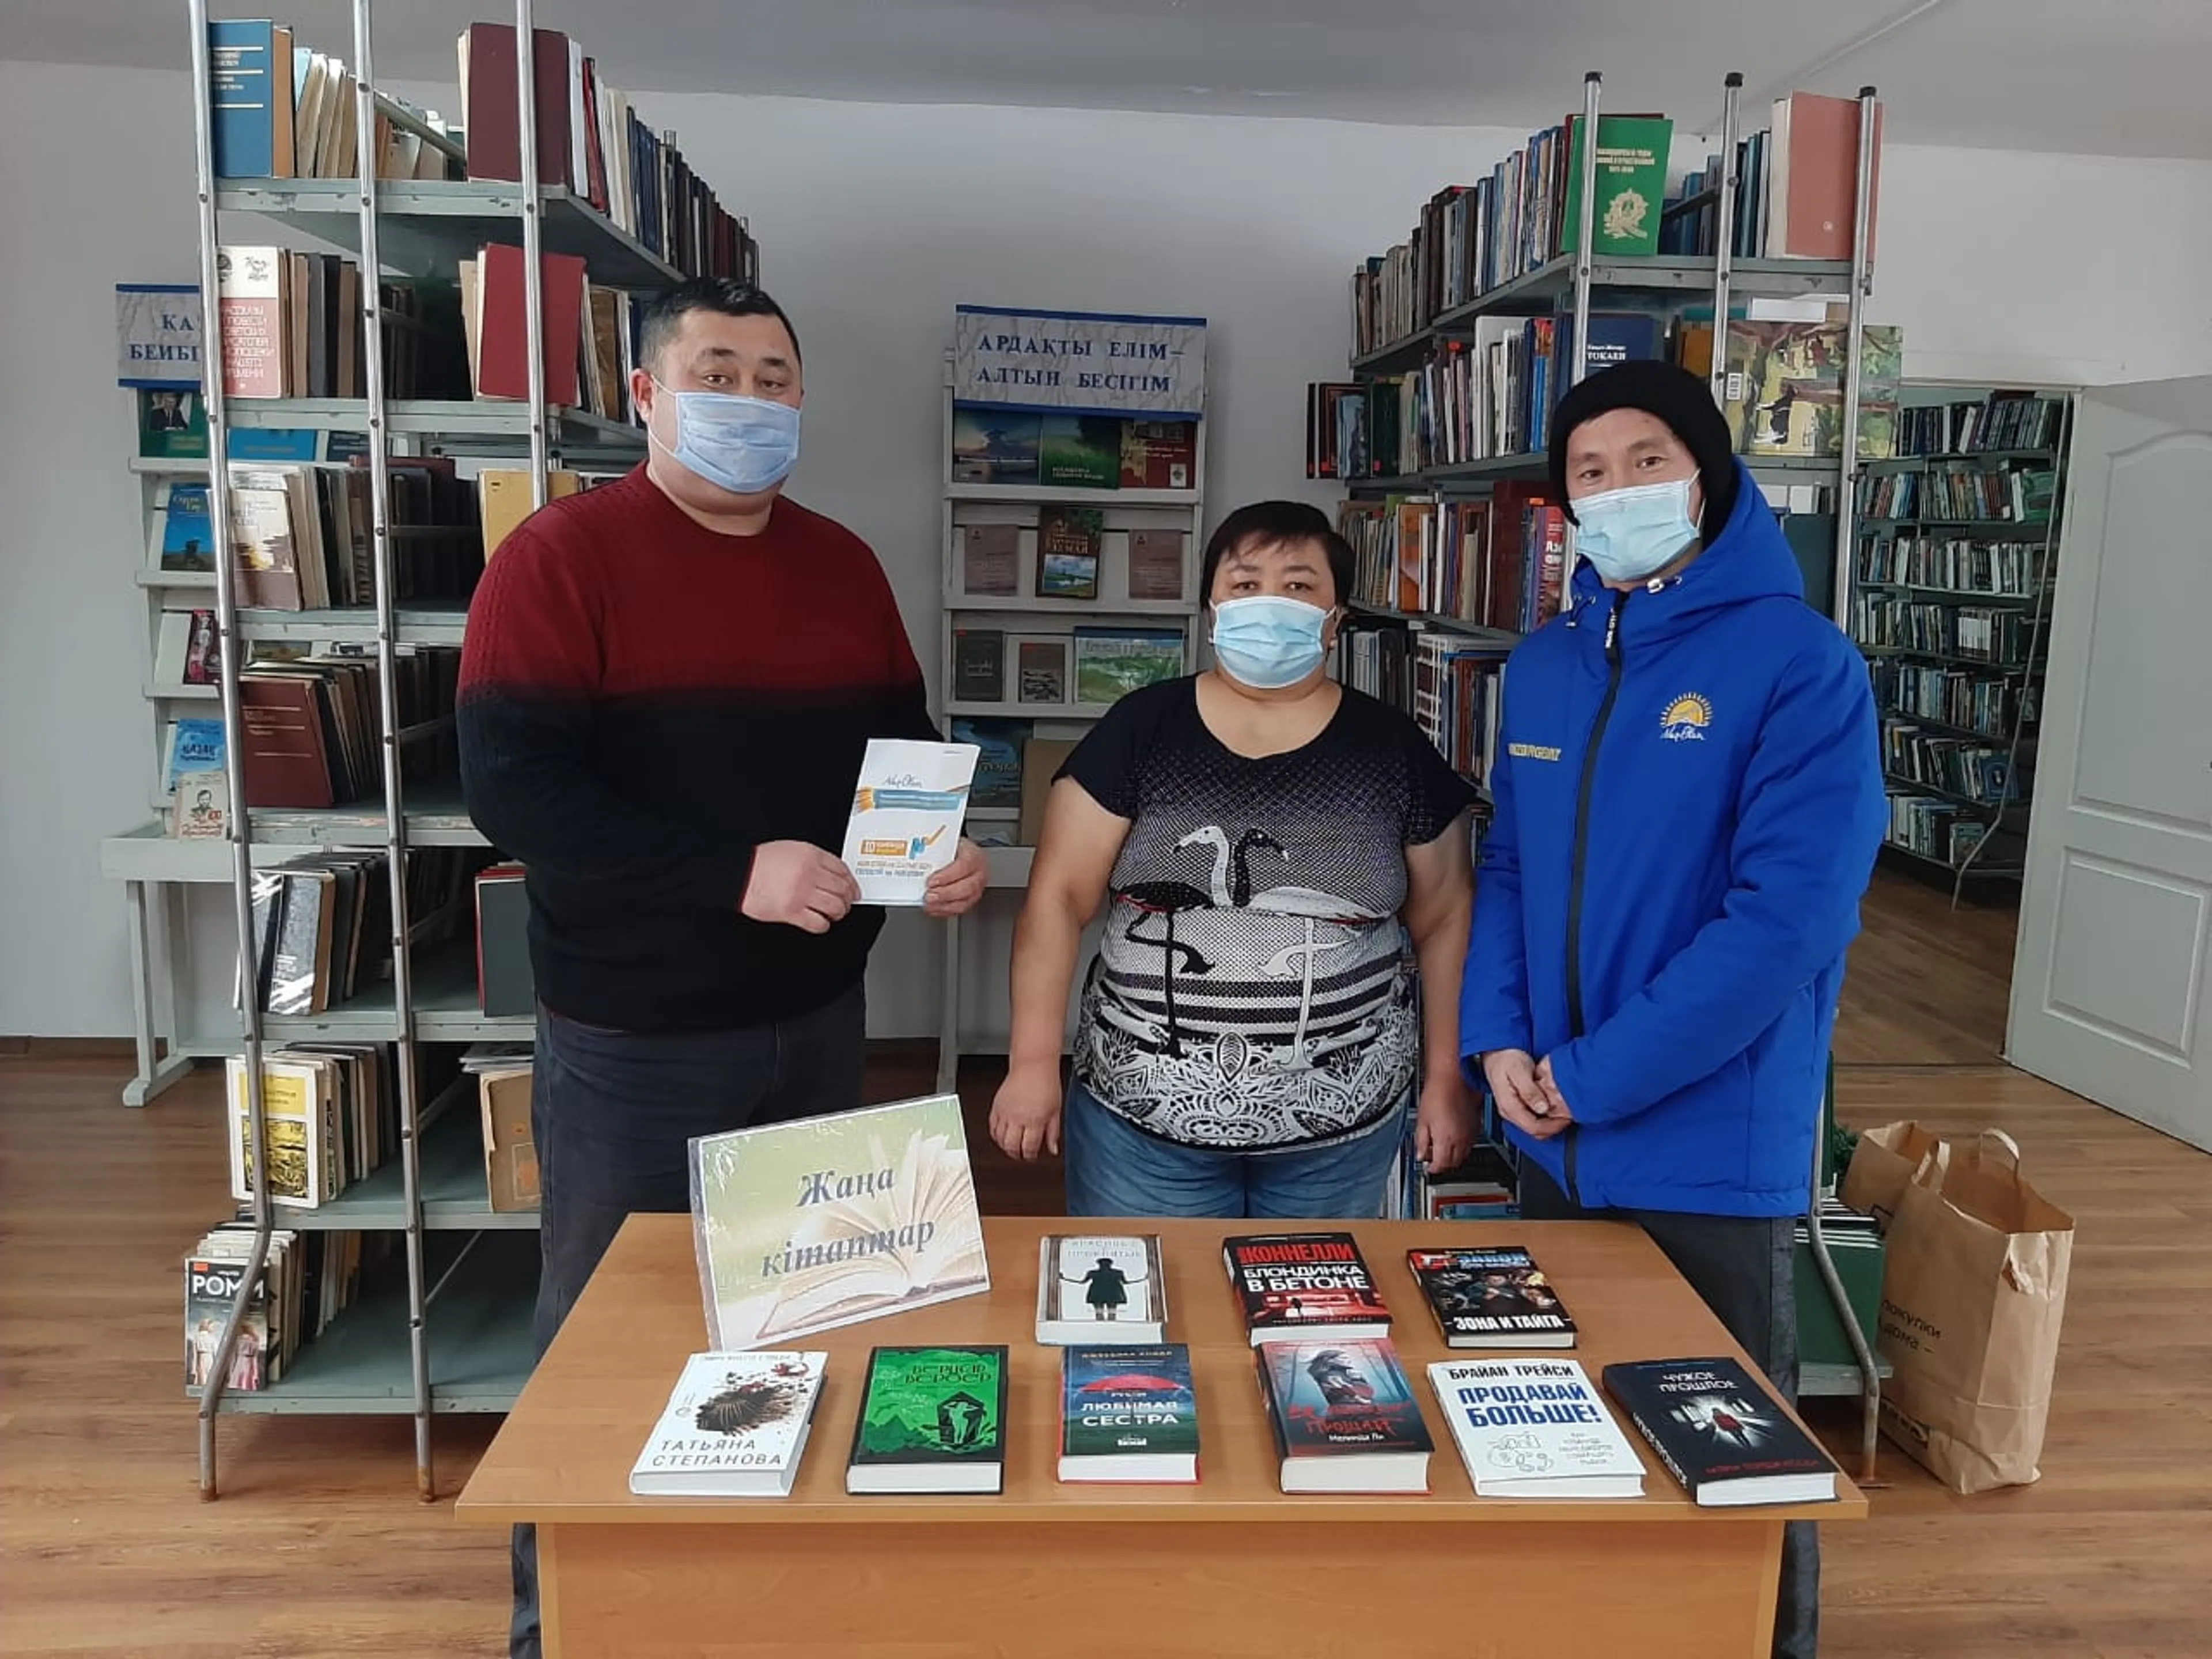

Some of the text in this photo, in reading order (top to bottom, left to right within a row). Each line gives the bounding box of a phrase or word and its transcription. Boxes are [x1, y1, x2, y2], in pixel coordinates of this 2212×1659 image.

[979, 334, 1092, 358] АРДАҚТЫ
[978, 369, 1171, 392] АЛТЫН БЕСІГІМ
[797, 1166, 895, 1207] Жаңа
[761, 1220, 935, 1277] кітаптар
[1243, 1266, 1364, 1278] БЛОНДИНКА
[1247, 1277, 1369, 1292] В БЕТОНЕ
[1453, 1317, 1499, 1330] ЗОНА
[1512, 1313, 1565, 1328] ТАЙГА
[1449, 1363, 1574, 1380] БРАЙАН ТРЕЙСИ
[1457, 1383, 1589, 1405] ПРОДАВАЙ
[1660, 1380, 1739, 1392] ПРОШЛОЕ
[1082, 1414, 1179, 1426] СЕСТРА
[1465, 1404, 1601, 1427] БОЛЬШЕ!
[662, 1440, 756, 1450] ТАТЬЯНА
[653, 1454, 781, 1466] СТЕПАНОВА
